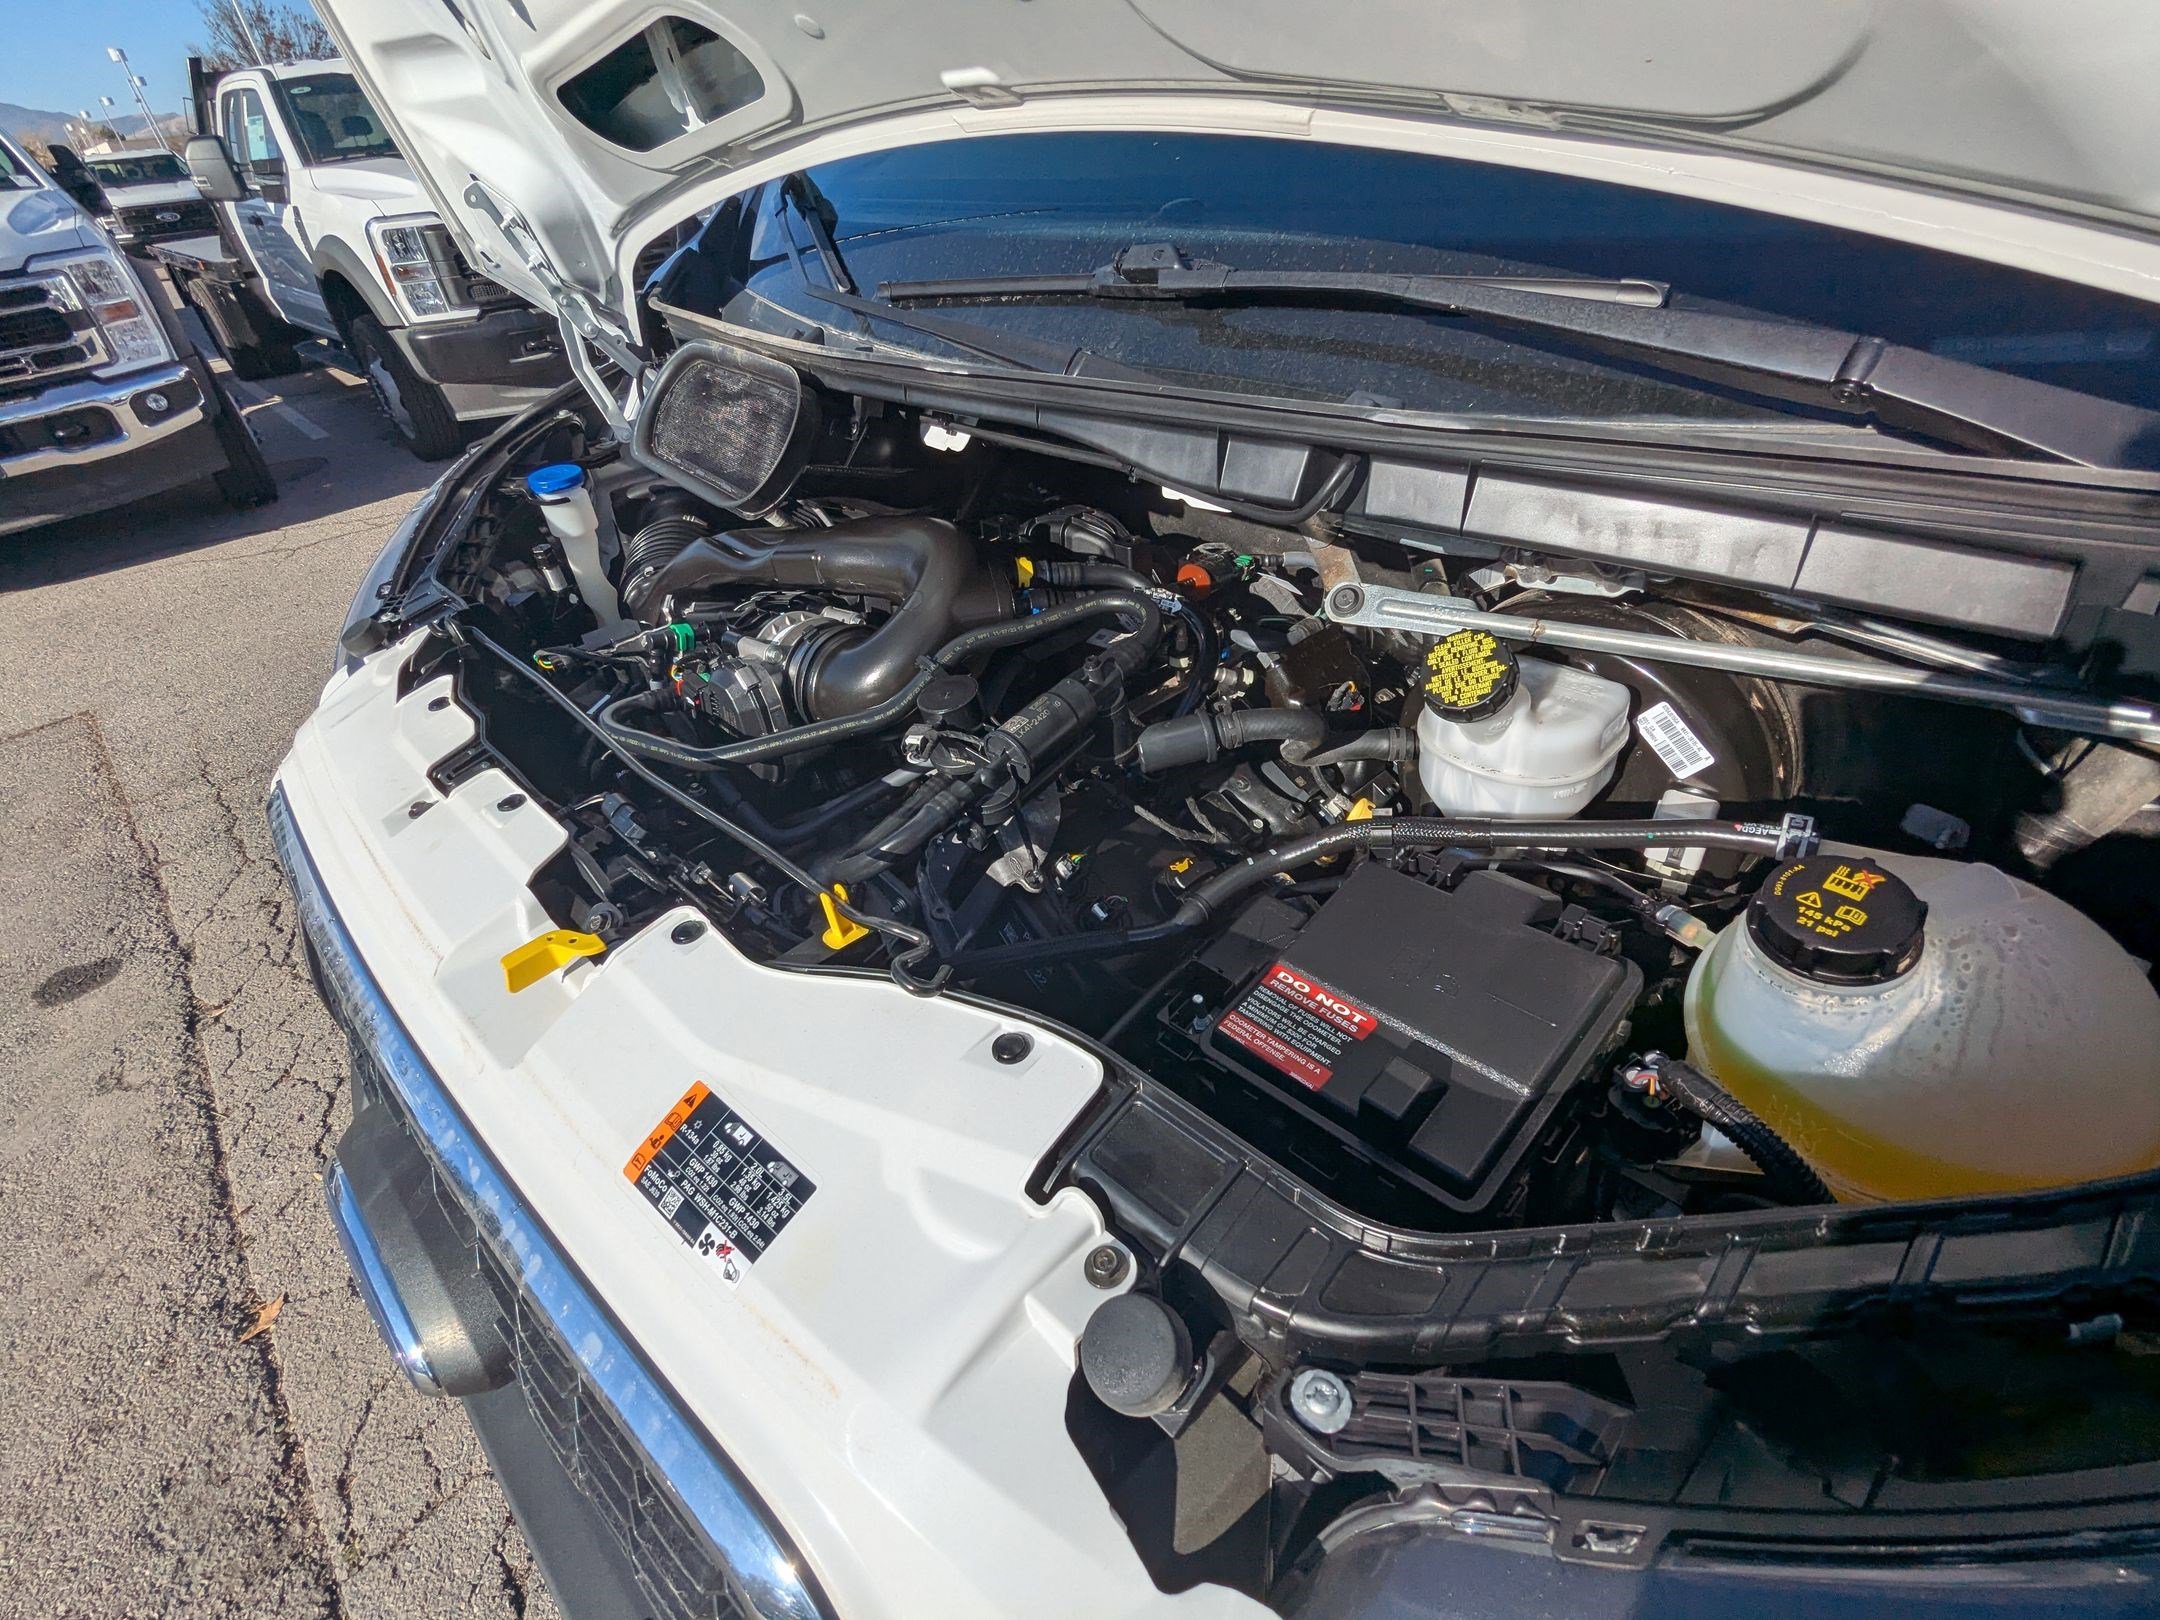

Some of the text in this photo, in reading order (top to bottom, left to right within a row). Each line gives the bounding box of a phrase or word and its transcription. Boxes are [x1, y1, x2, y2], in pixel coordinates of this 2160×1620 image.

[1434, 643, 1452, 651] CLEAN
[1454, 637, 1472, 646] FILLER
[1444, 654, 1453, 662] DOT
[1462, 648, 1478, 656] FLUID
[1480, 642, 1496, 651] FROM
[1429, 651, 1449, 659] BEFORE
[1439, 659, 1459, 669] SEALED
[1472, 660, 1498, 672] BOUCHON
[1425, 681, 1441, 690] AVANT
[1461, 680, 1492, 693] PROVENANT
[1479, 673, 1501, 683] LIQUIDE
[1460, 687, 1491, 700] CONTENANT
[1796, 916, 1838, 938] 21 psi
[1798, 906, 1851, 932] 145 kPa
[1269, 979, 1359, 1033] REMOVE FUSES
[1276, 971, 1367, 1026] DO NOT
[1253, 990, 1343, 1045] DISENGAGE THE ODOMETER.
[1257, 985, 1353, 1043] REMOVAL OF FUSES WILL NOT
[1238, 1007, 1332, 1067] TAMPERING WITH EQUIPMENT.
[1246, 997, 1342, 1056] VIOLATORS WILL BE CHARGED
[1247, 1005, 1277, 1025] MINIMUM
[1276, 1023, 1287, 1031] OF
[1301, 1038, 1317, 1049] FOR
[1223, 1020, 1253, 1041] FEDERAL
[1253, 1039, 1286, 1061] OFFENSE.
[1229, 1015, 1266, 1039] ODOMETER
[1266, 1037, 1306, 1065] TAMPERING
[679, 1124, 701, 1146] R-134a
[710, 1151, 718, 1159] 30
[712, 1140, 734, 1163] 0.85 kg
[685, 1167, 695, 1178] CO2
[688, 1157, 718, 1188] GWP 1430
[711, 1163, 721, 1173] lbs
[750, 1162, 766, 1178] 2.0L
[644, 1165, 670, 1193] FoMoCo
[740, 1168, 761, 1191] 1.35 kg
[712, 1194, 723, 1206] CO2
[738, 1189, 750, 1201] lbs
[765, 1191, 791, 1218] 1.425 kg
[777, 1188, 794, 1204] 3.5L
[680, 1179, 696, 1196] PAG
[693, 1193, 738, 1240] WSH-M1C231-B
[728, 1197, 760, 1230] GWP 1430
[756, 1207, 777, 1228] 3.14 lbs
[765, 1203, 773, 1212] 50
[737, 1220, 749, 1232] CO2
